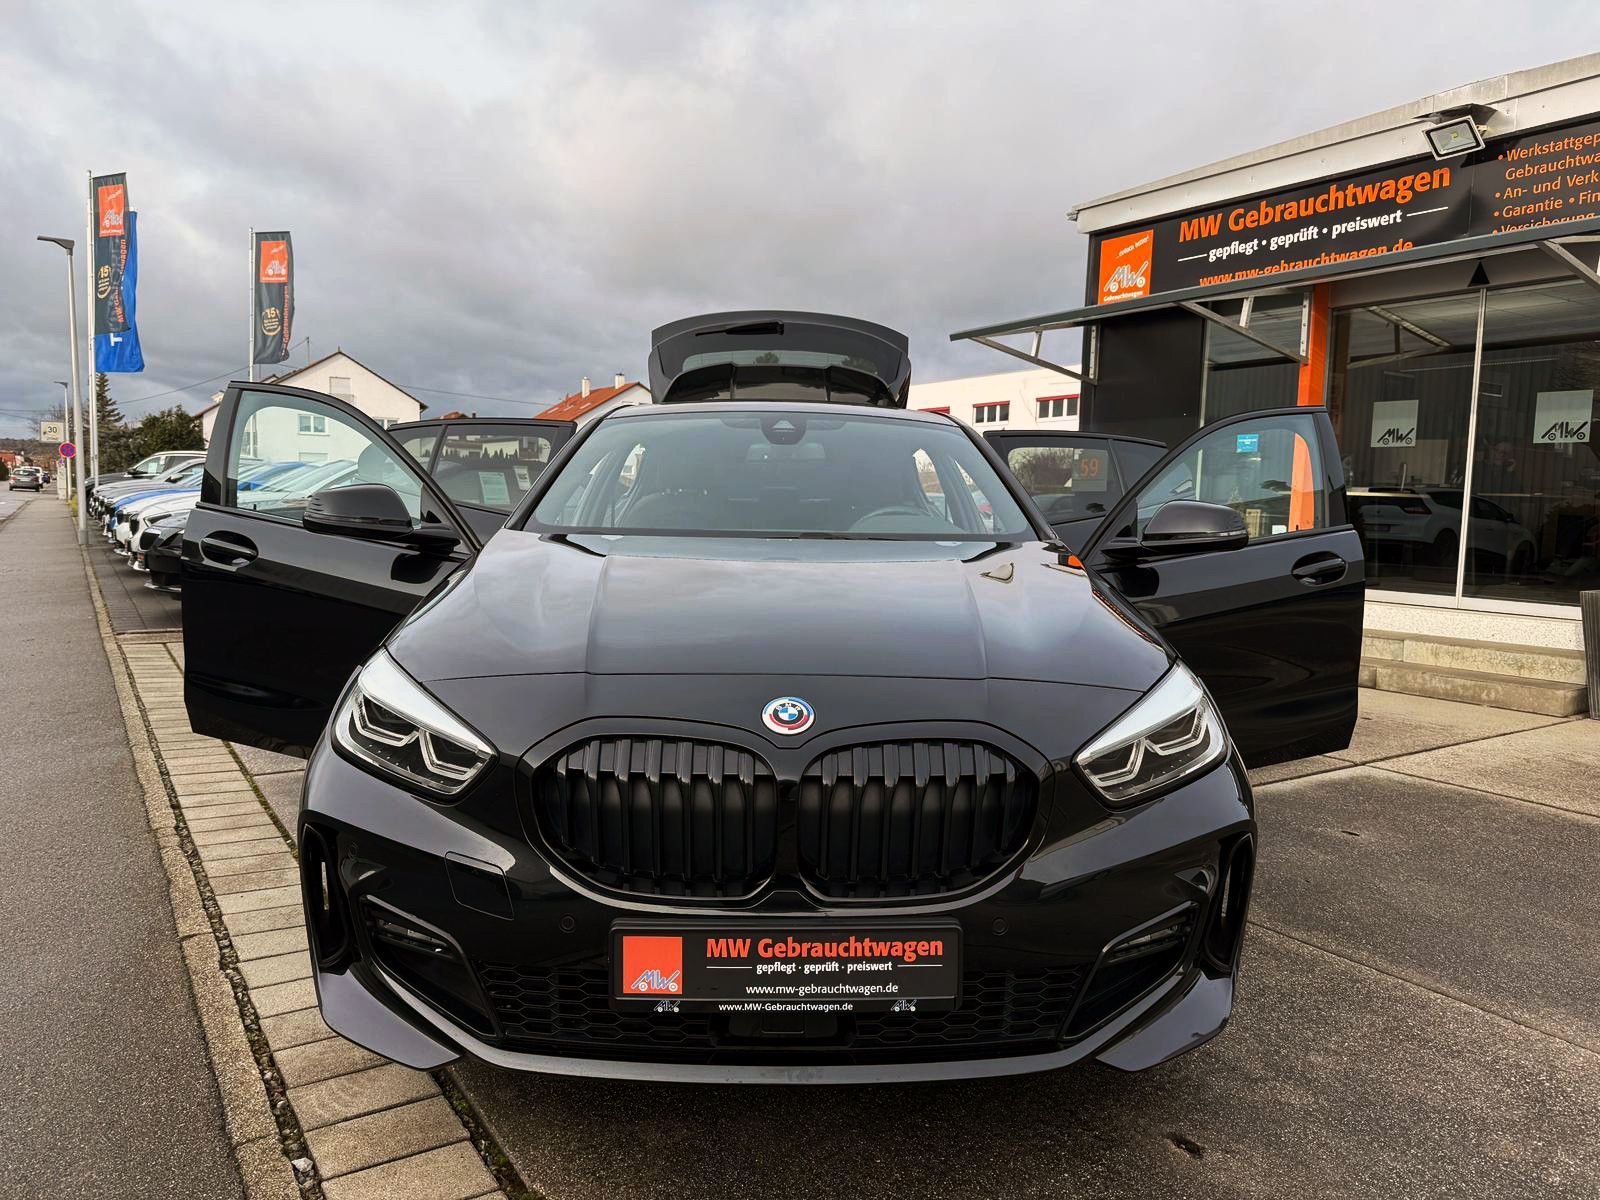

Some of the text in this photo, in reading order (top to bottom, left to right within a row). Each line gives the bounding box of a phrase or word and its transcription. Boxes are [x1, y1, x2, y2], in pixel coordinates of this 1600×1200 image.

[1507, 133, 1600, 161] Werkstattgep
[1505, 154, 1600, 180] Gebrauchtwa
[1503, 169, 1600, 199] An- und Verk
[1178, 167, 1451, 243] MW Gebrauchtwagen
[1502, 190, 1600, 218] Garantie Fin
[1208, 210, 1403, 262] gepflegt geprüft preiswert
[1199, 239, 1413, 287] wwwmw-gebrauchtwagende
[706, 936, 943, 962] MW Gebrauchtwagen
[756, 961, 892, 975] gepflegt geprüft preiswert
[745, 982, 899, 996] www.mw-gebrauchtwagen.de
[718, 1002, 853, 1013] www.MW-Gebrauchtwagen.de
